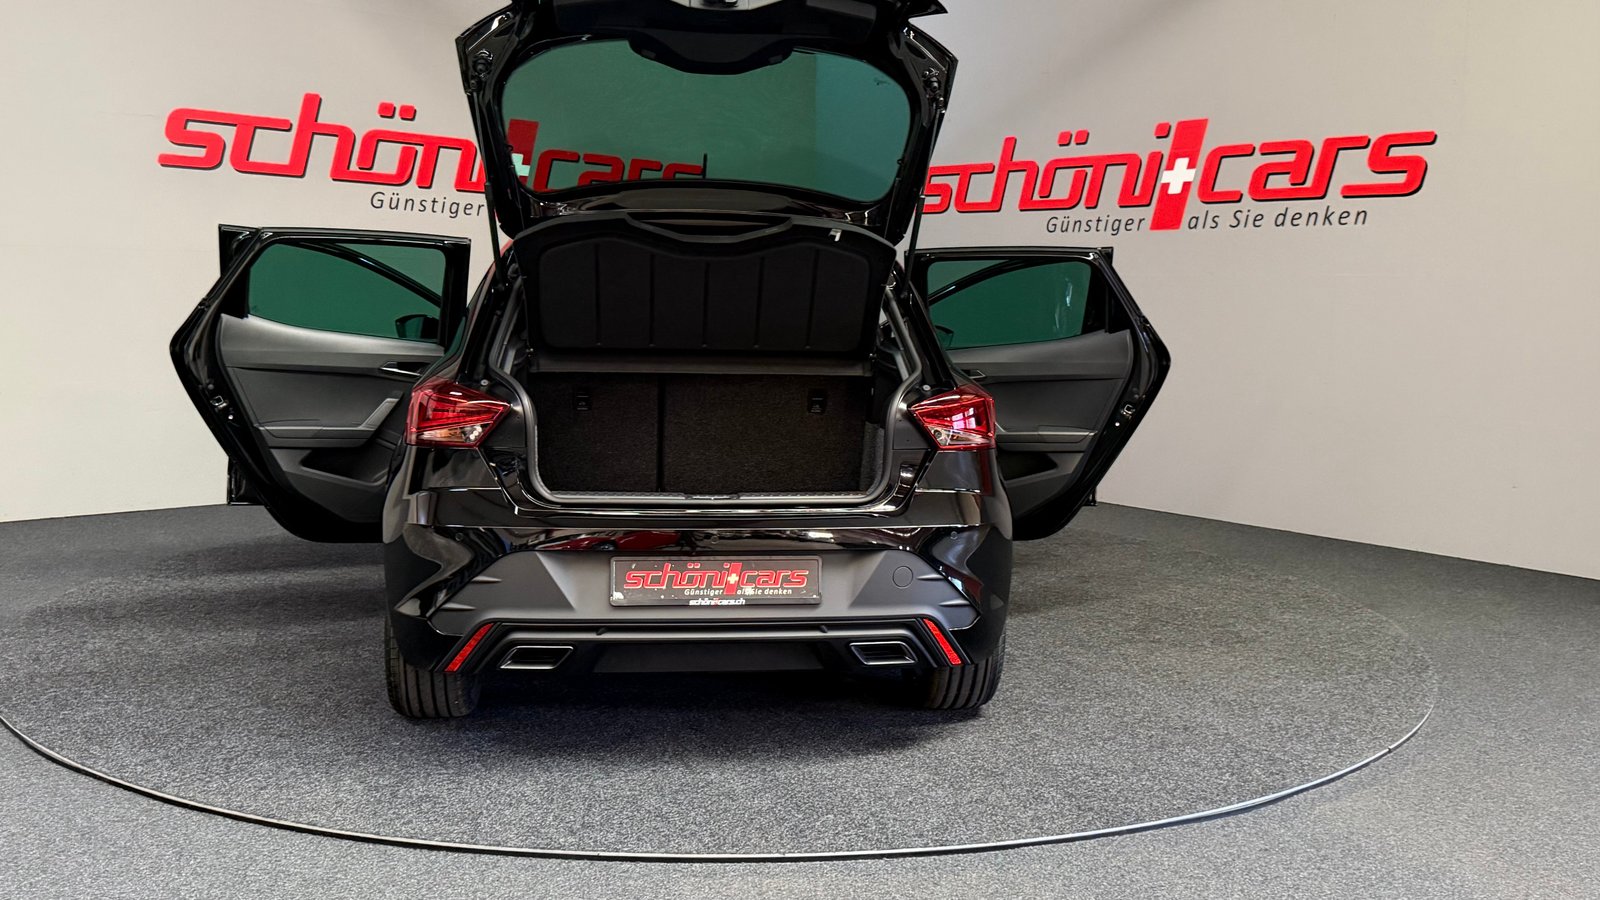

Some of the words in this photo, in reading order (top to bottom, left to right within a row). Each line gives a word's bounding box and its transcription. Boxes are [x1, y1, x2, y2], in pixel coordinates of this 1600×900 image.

[157, 93, 486, 194] schön
[1197, 130, 1437, 204] cars
[370, 191, 485, 218] Günstiger
[1046, 216, 1145, 234] Günstiger
[1187, 211, 1220, 230] als
[1229, 208, 1264, 229] Sie
[1274, 207, 1369, 228] denken
[684, 588, 723, 596] Günstiger
